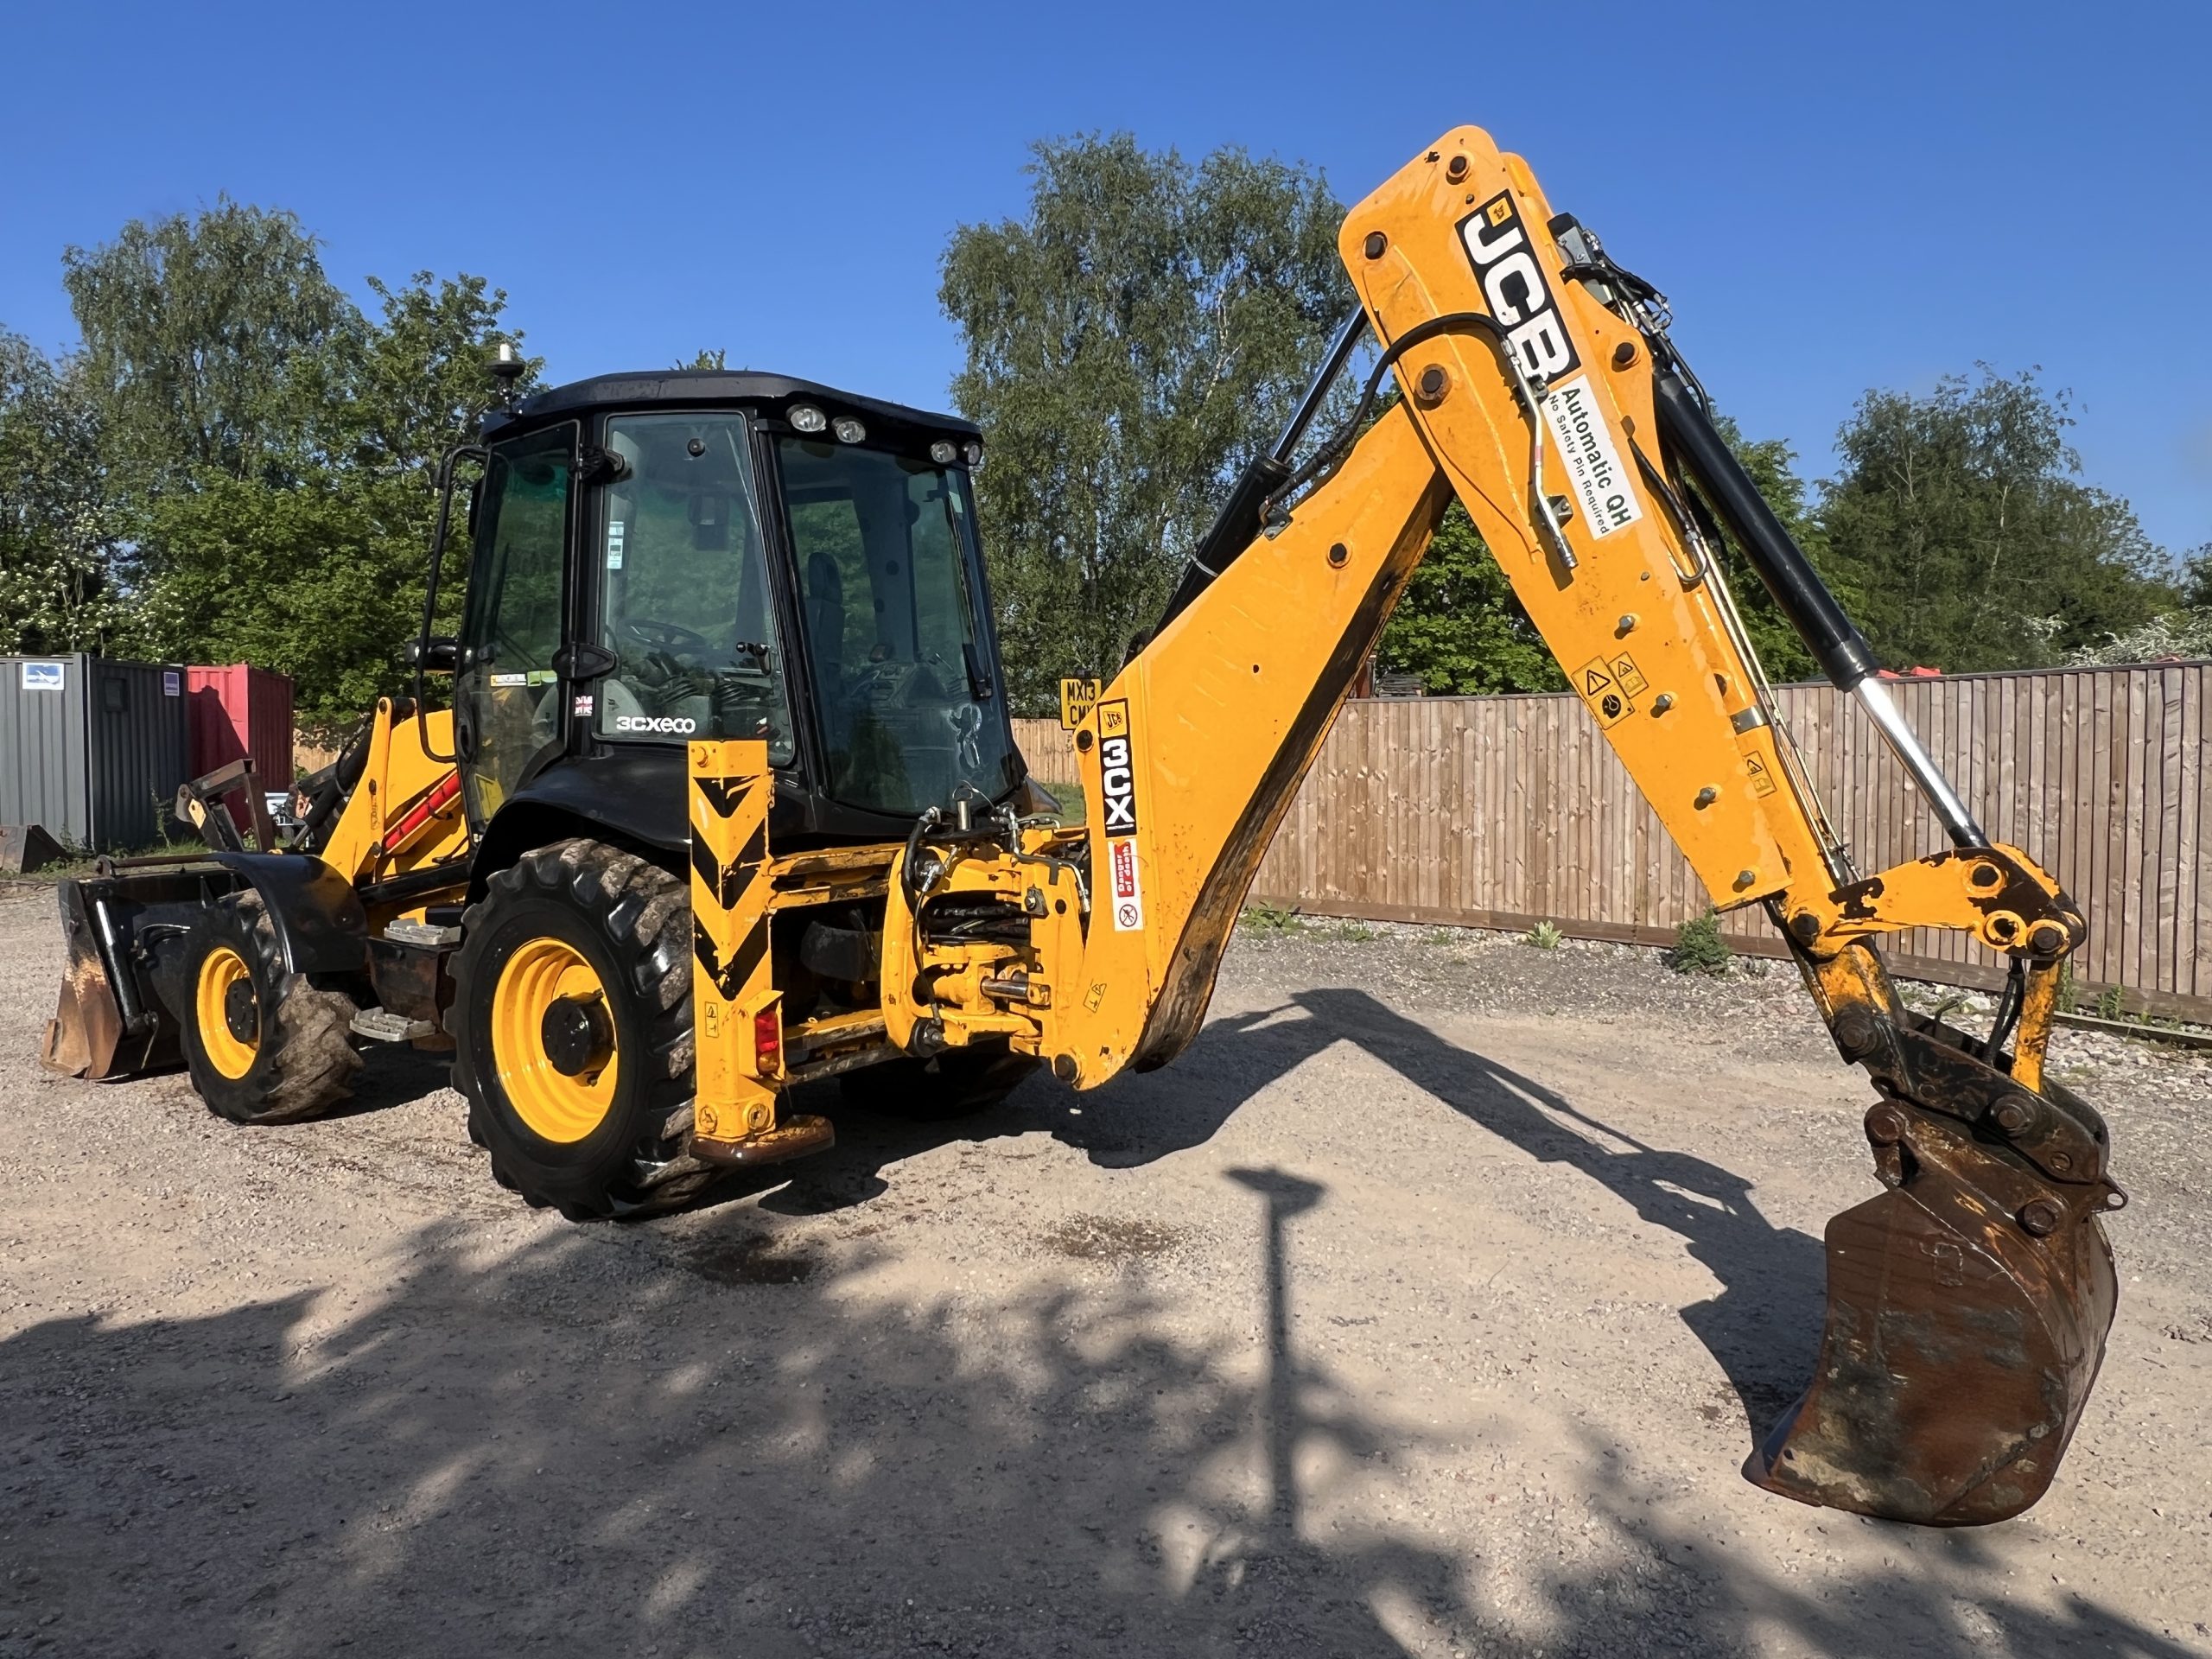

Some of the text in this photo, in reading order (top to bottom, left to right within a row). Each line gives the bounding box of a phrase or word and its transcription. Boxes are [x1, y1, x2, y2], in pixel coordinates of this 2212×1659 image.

[1464, 213, 1571, 382] JCB
[1548, 394, 1611, 535] No Safety Pin Required
[1560, 387, 1632, 527] Automatic QH
[1067, 681, 1096, 702] MX13
[1070, 704, 1090, 726] CM
[1103, 738, 1135, 825] 3CX
[1116, 854, 1125, 893] Danger
[1122, 845, 1133, 893] of death
